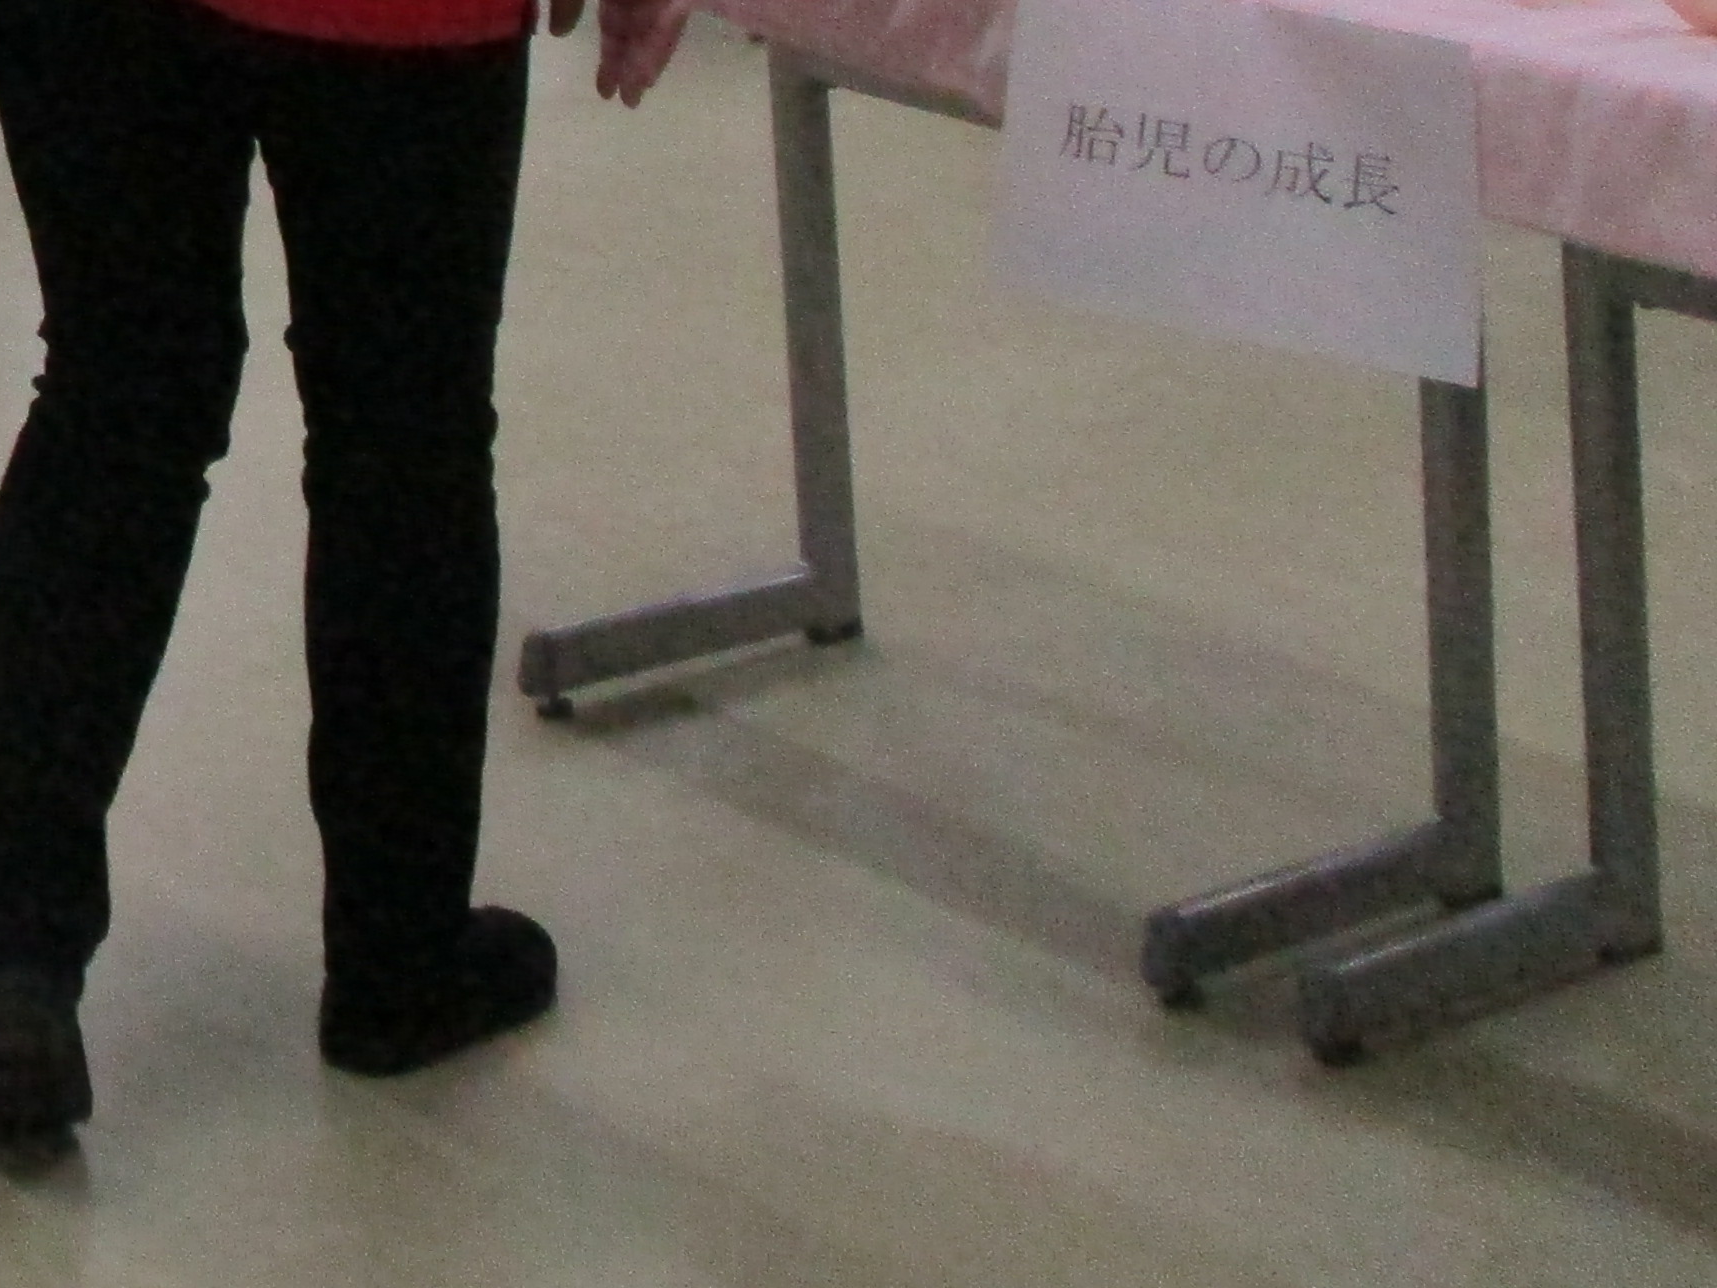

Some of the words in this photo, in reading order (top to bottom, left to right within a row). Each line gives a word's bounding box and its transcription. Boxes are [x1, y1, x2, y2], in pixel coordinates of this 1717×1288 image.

[1058, 104, 1400, 215] 胎児の成長
